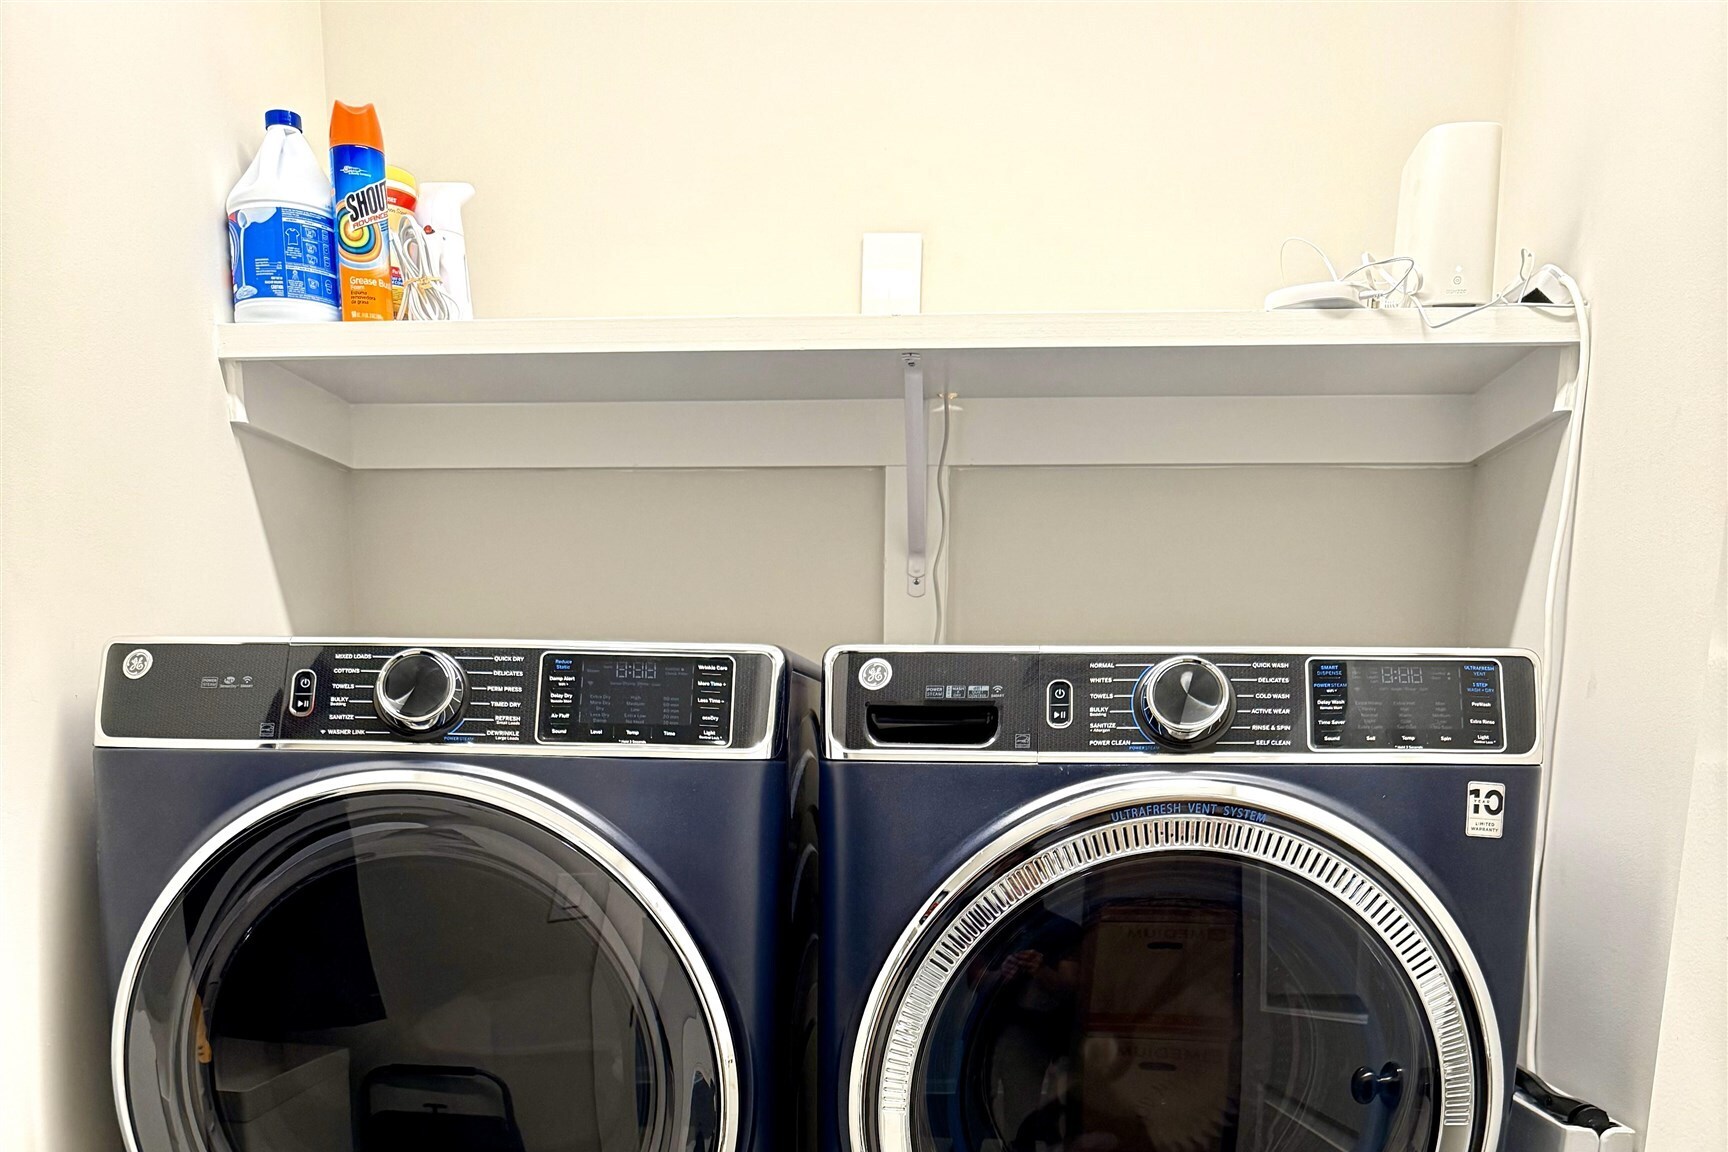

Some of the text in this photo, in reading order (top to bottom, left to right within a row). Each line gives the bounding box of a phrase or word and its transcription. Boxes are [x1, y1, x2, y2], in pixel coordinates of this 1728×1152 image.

[350, 276, 377, 286] Grease
[1470, 789, 1503, 815] 10
[1111, 803, 1267, 823] ULTRAFRESH VENT SYSTEM
